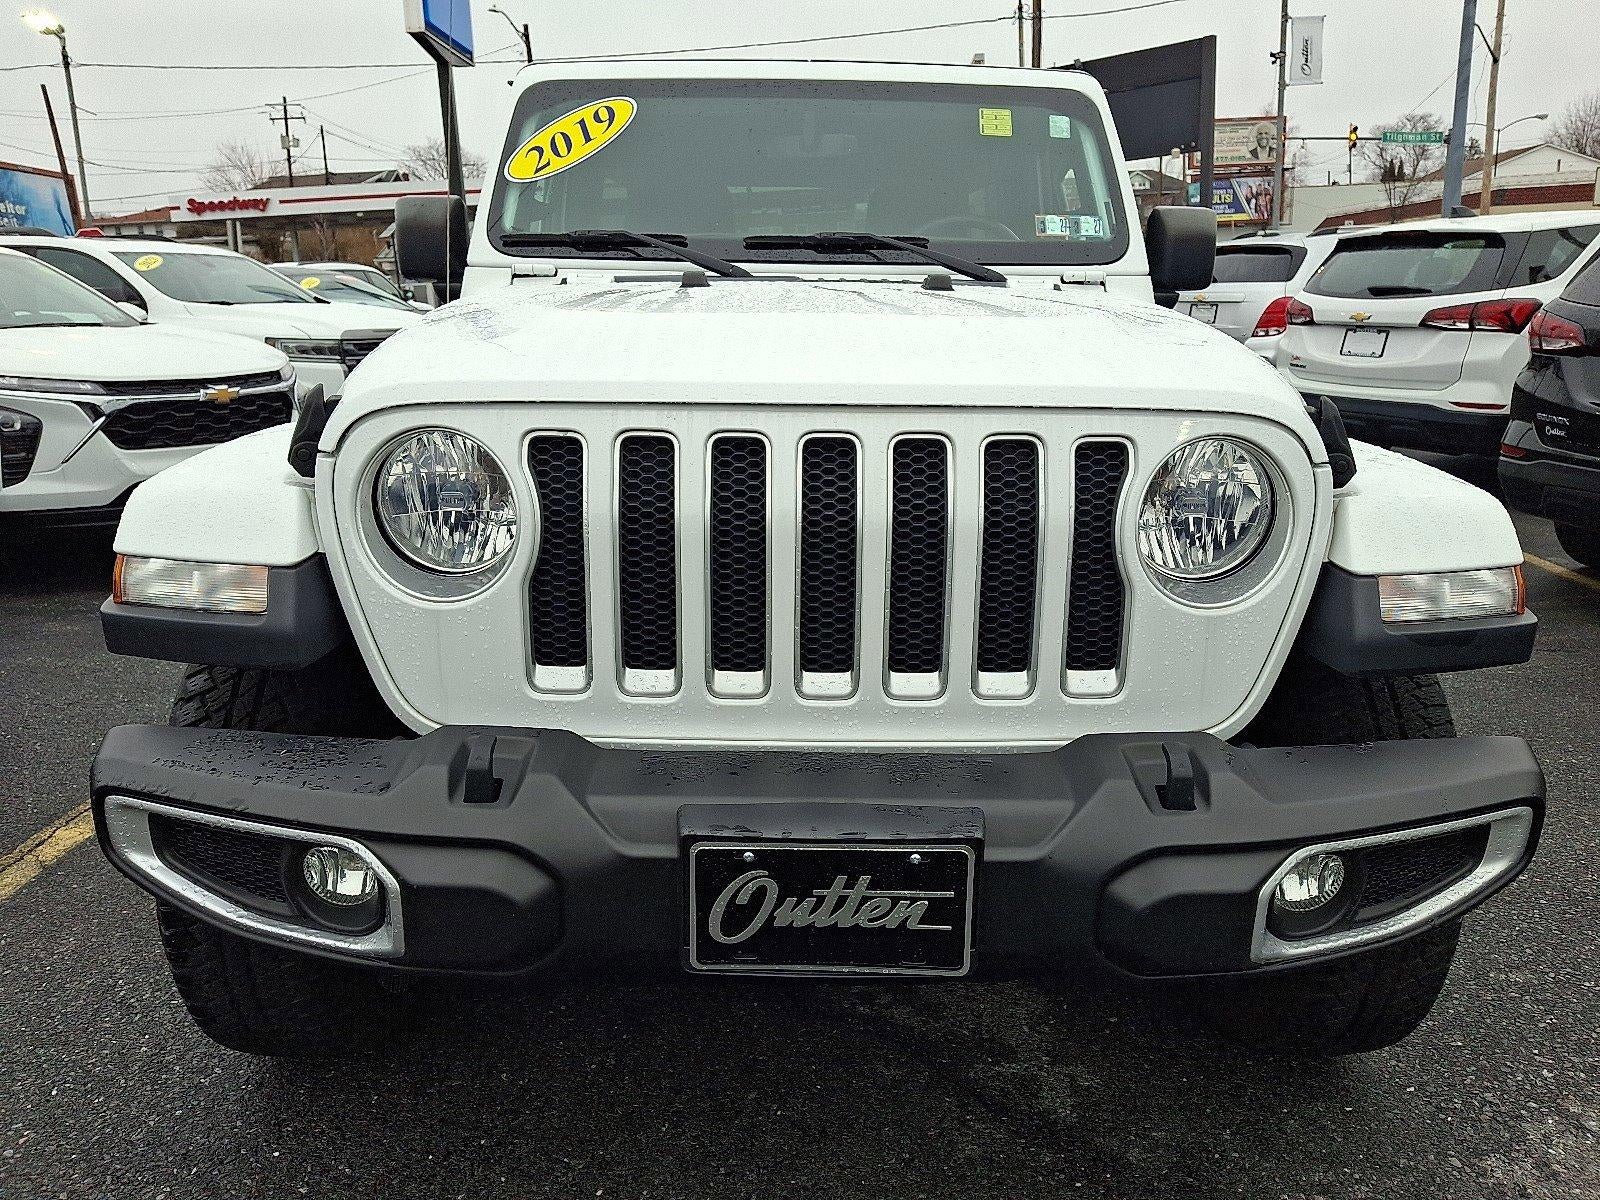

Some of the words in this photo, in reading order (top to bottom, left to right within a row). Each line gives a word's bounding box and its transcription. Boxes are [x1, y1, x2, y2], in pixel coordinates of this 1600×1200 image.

[1301, 36, 1311, 77] Outten
[525, 105, 616, 175] 2019
[1386, 132, 1427, 143] Tilghman
[1430, 132, 1440, 141] St
[187, 196, 270, 216] Speedway
[708, 869, 954, 944] Outten
